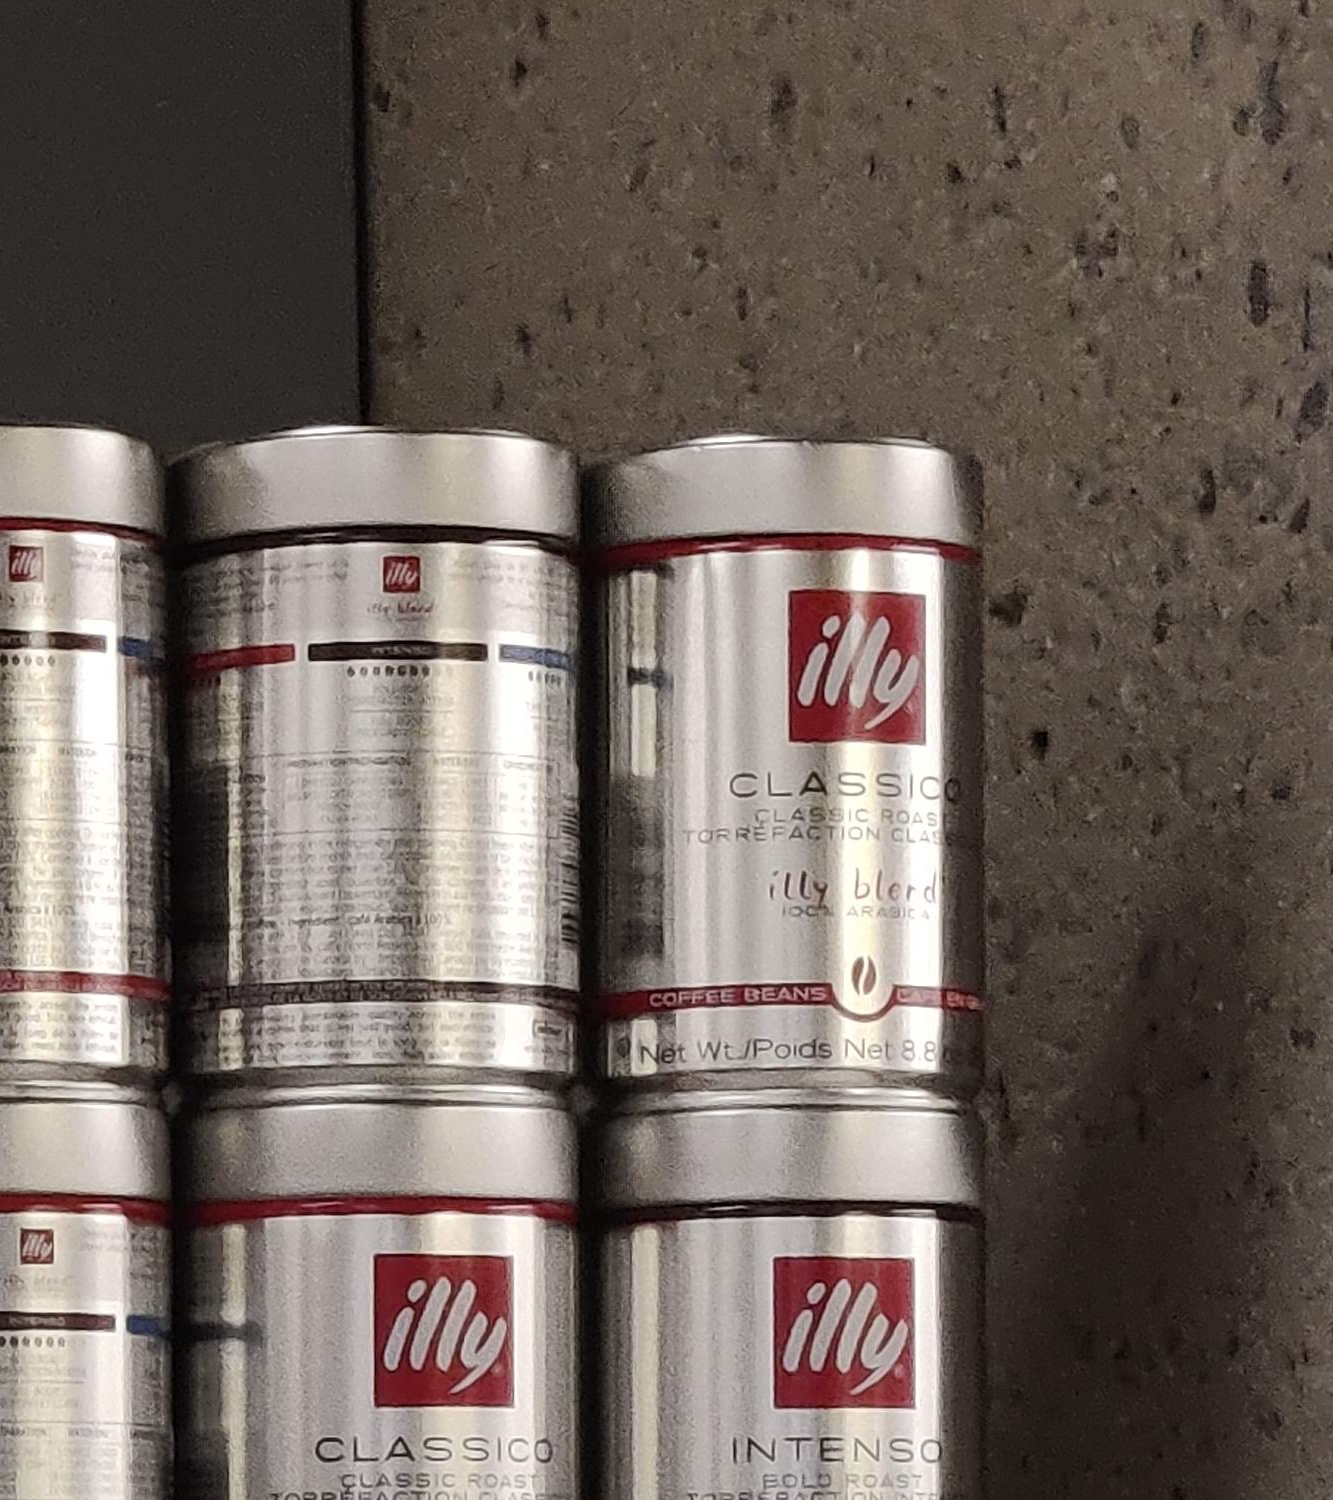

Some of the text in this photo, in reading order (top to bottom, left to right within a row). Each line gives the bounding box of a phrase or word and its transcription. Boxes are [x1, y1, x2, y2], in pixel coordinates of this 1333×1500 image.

[797, 612, 920, 730] illy
[730, 772, 961, 803] CLASSICO
[755, 808, 870, 824] CLASSIC
[770, 870, 828, 907] illy
[649, 987, 827, 1008] COFFEE BEANS
[640, 1038, 892, 1064] Net Net
[384, 1276, 506, 1395] illy
[784, 1278, 908, 1396] illy
[315, 1437, 553, 1463] CLASSICO
[733, 1436, 942, 1464] INTENSO
[342, 1473, 537, 1489] CLASSIC ROAST
